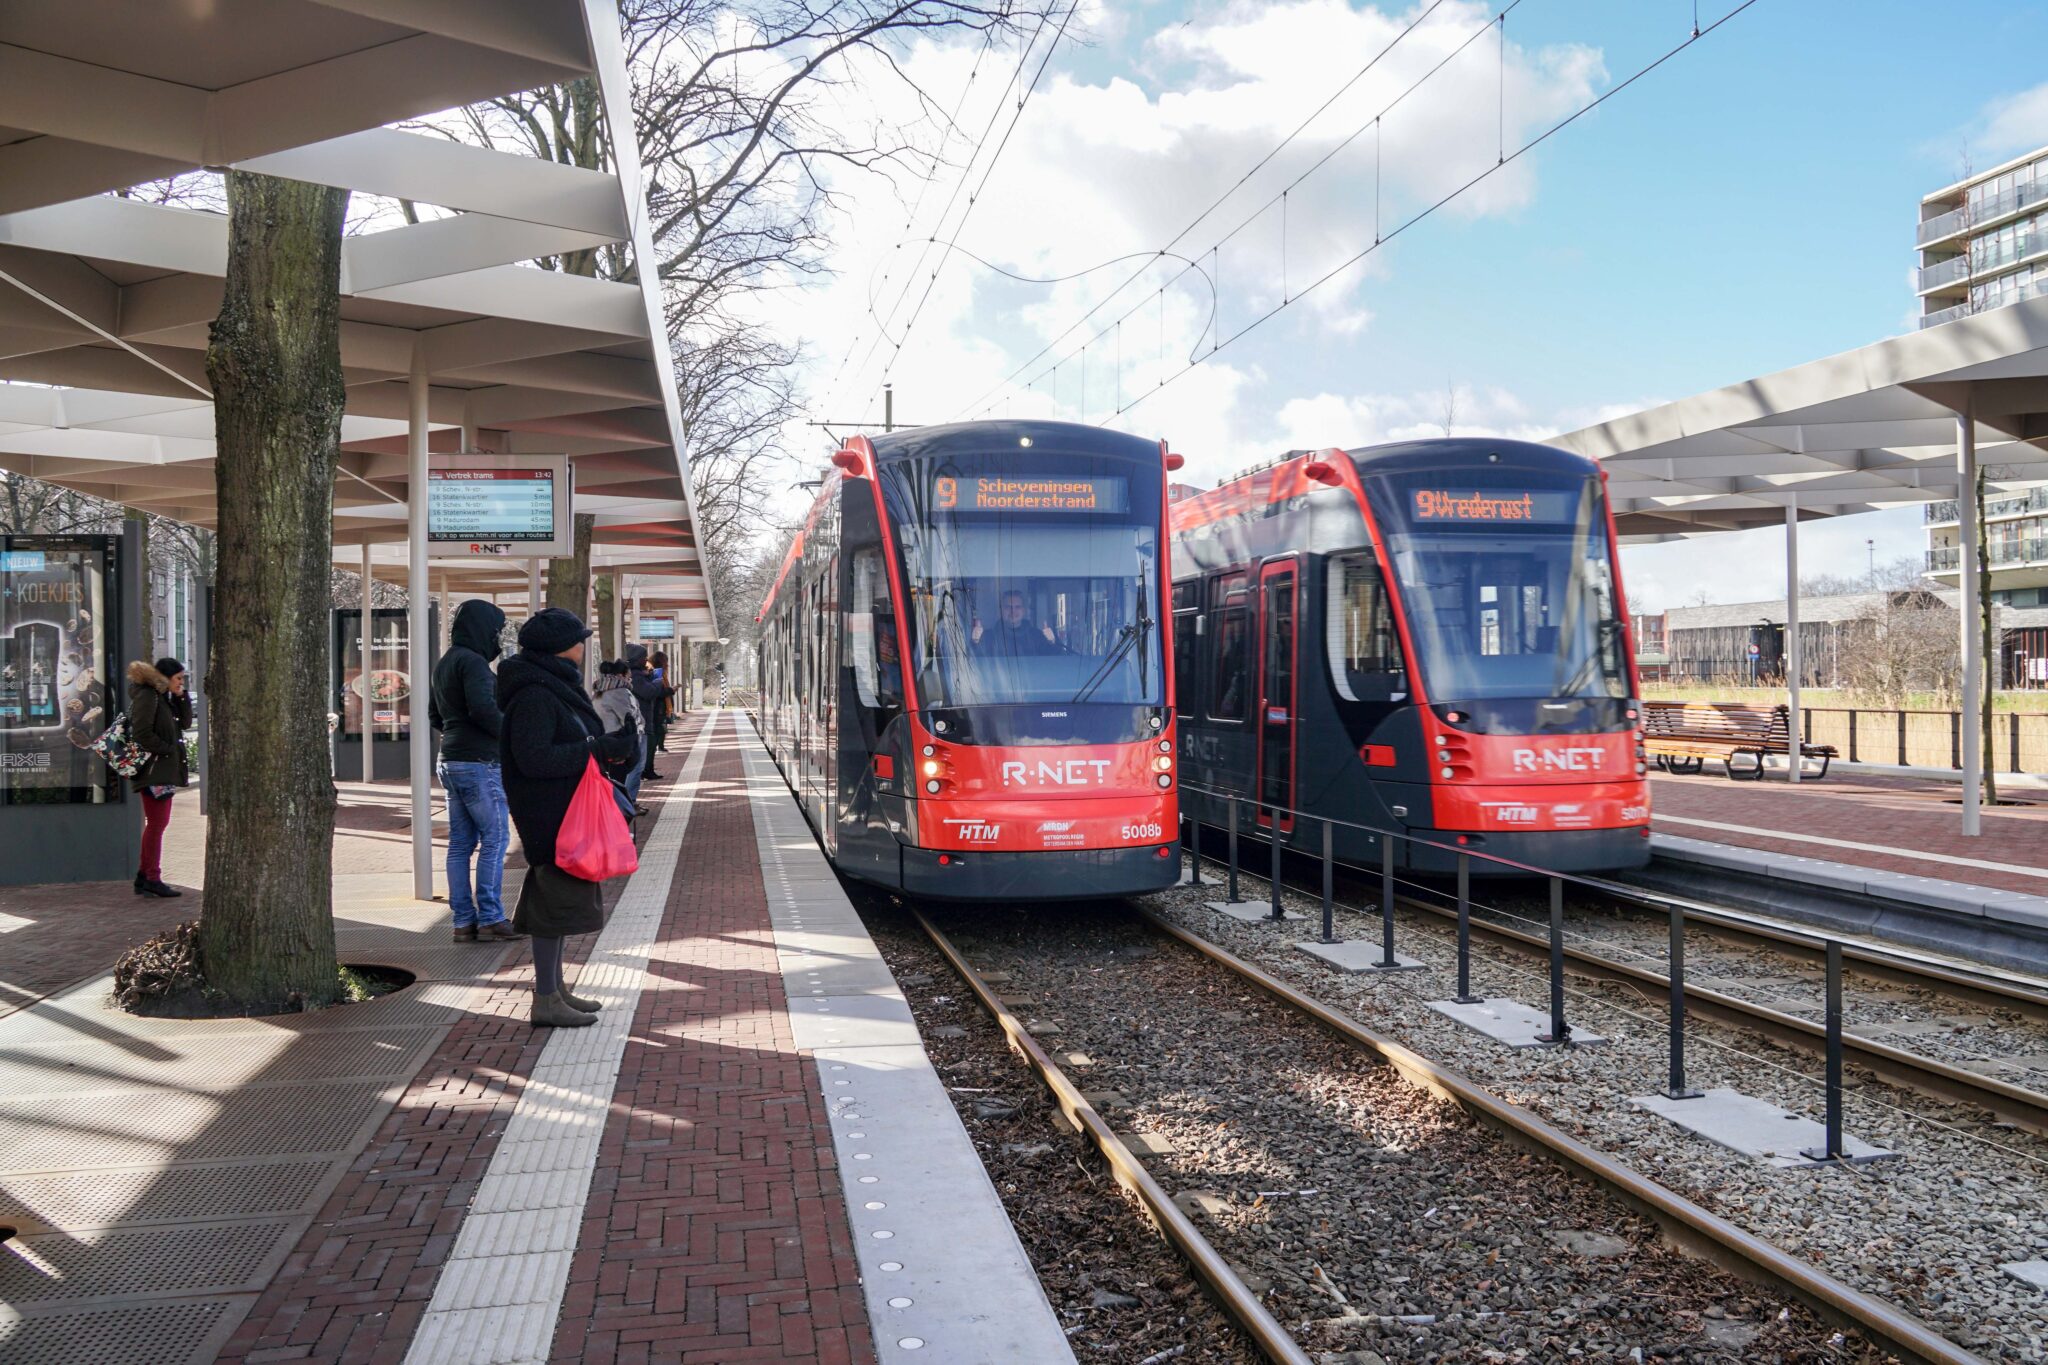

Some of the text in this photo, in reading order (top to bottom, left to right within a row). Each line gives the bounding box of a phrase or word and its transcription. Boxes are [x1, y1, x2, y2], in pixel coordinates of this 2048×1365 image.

[445, 471, 472, 479] Vertrek
[937, 477, 957, 507] 9
[977, 478, 1093, 494] Scheveningen
[976, 493, 1096, 509] Noorderstrand
[1416, 490, 1435, 518] 9
[7, 557, 39, 568] NIEUW
[17, 582, 84, 603] KOEKJES
[0, 752, 51, 767] AXE
[1497, 807, 1538, 821] HTM
[959, 824, 1000, 840] HTM
[1121, 824, 1162, 840] 5008b
